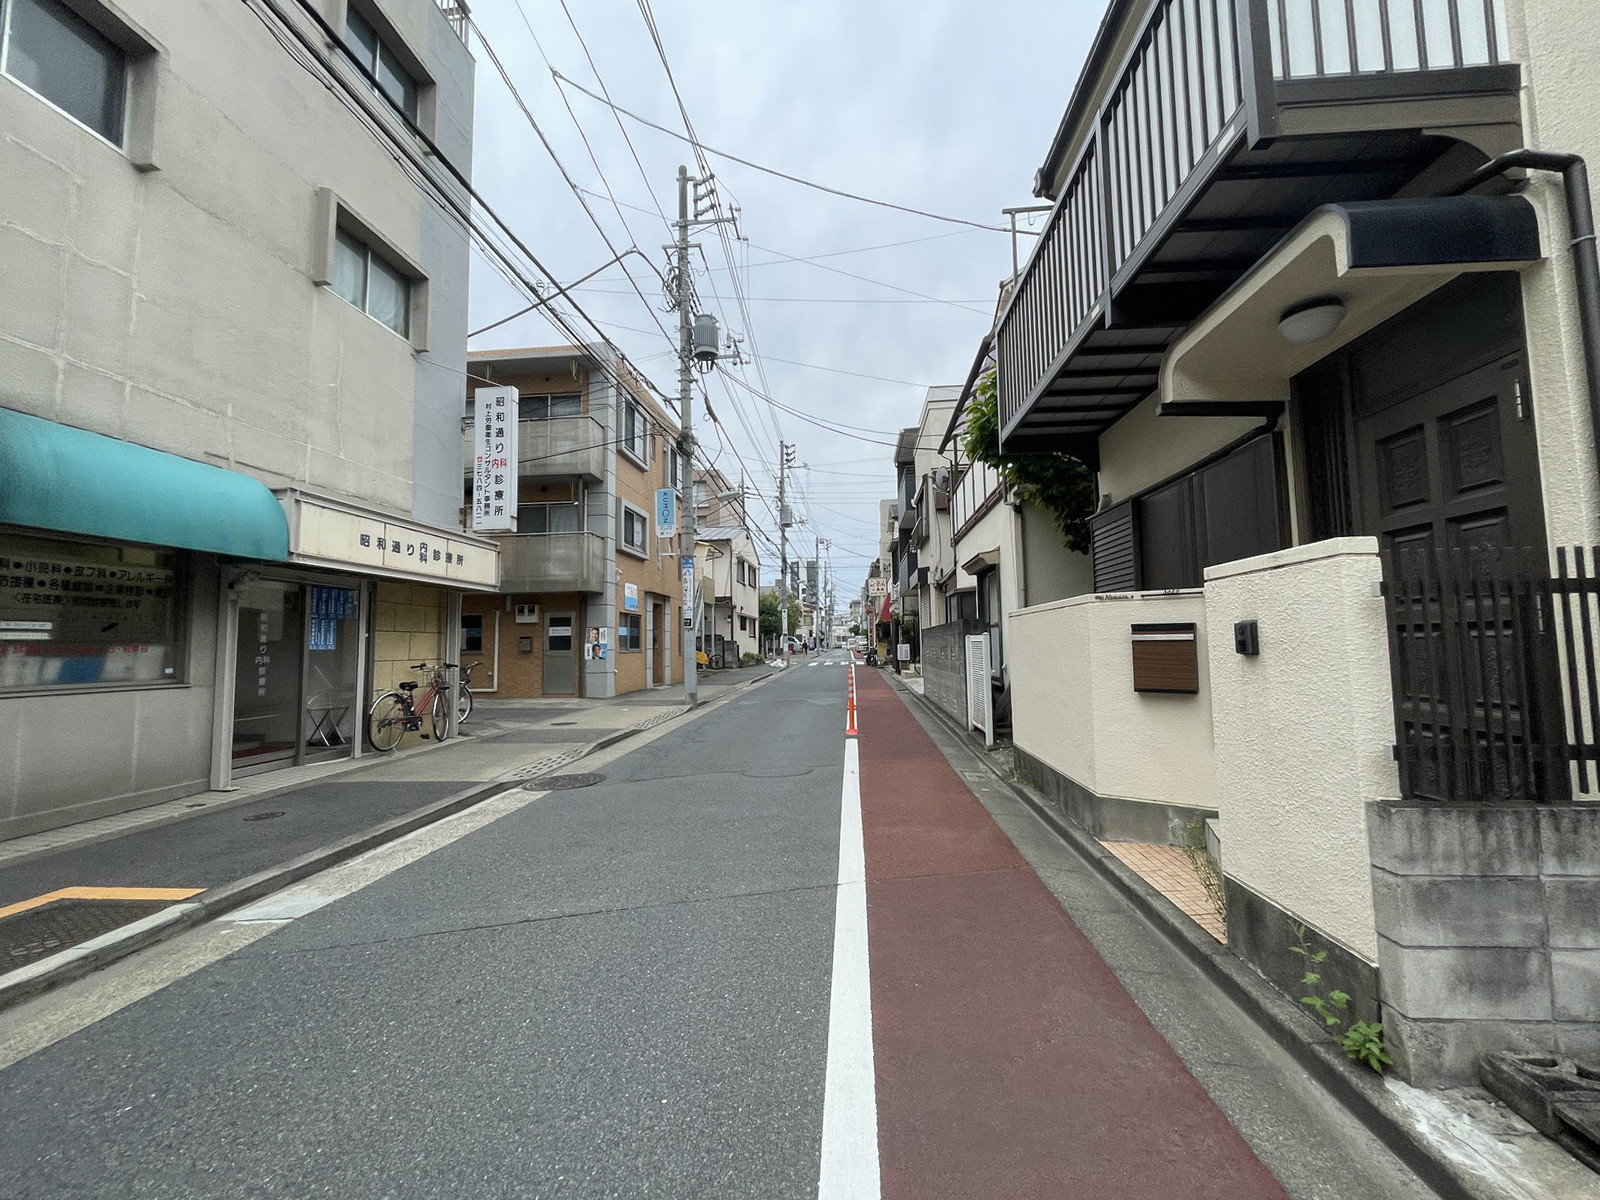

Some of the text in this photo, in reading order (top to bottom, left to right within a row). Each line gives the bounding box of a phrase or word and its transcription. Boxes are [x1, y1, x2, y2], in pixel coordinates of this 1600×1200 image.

[491, 396, 507, 517] 昭和通り内科診療所
[661, 491, 670, 525] KUMON
[359, 533, 465, 567] 昭和通り内科診療所
